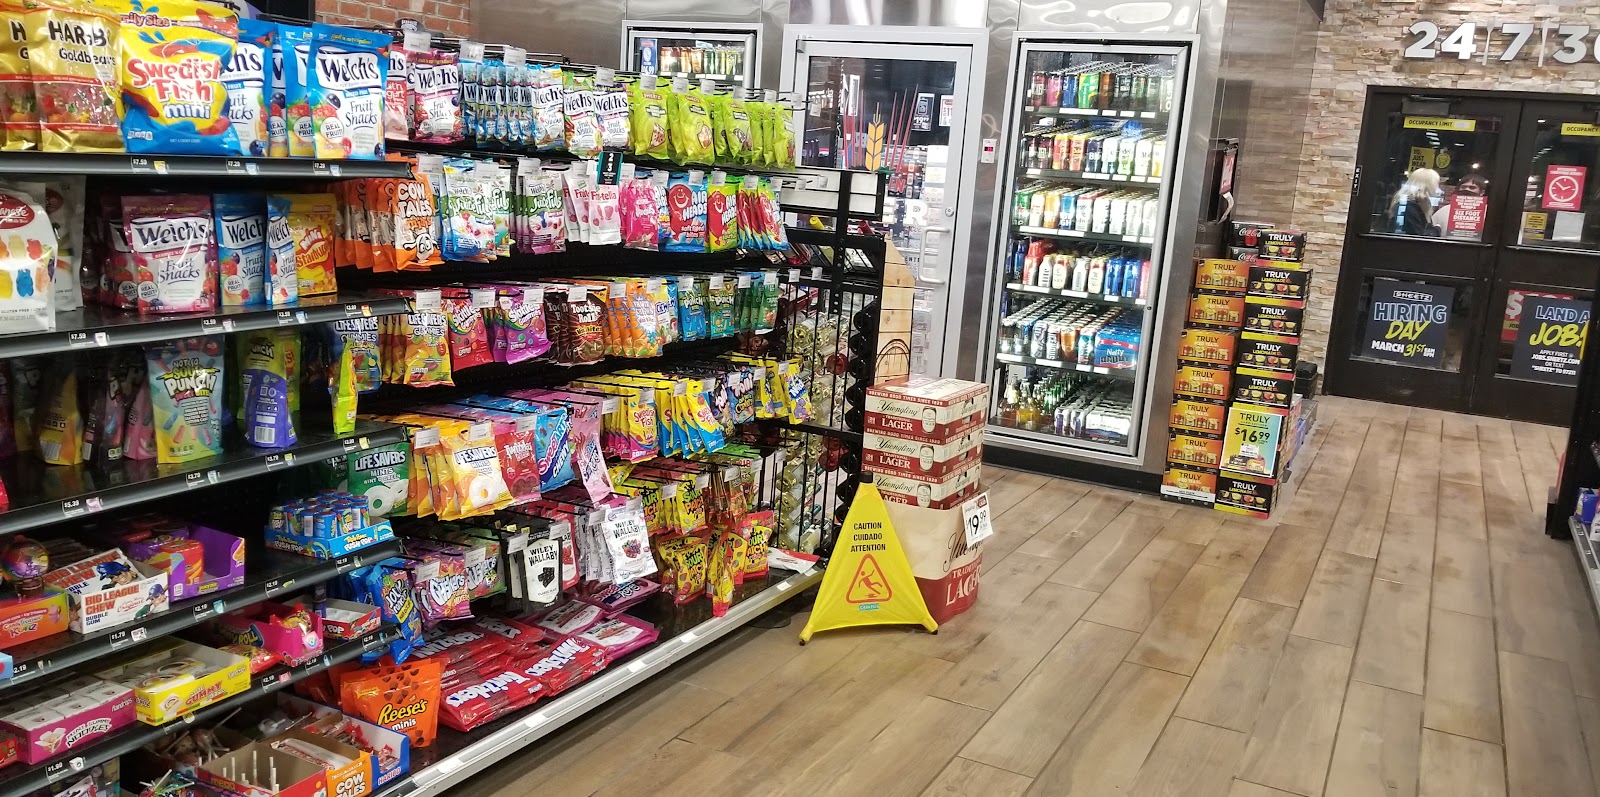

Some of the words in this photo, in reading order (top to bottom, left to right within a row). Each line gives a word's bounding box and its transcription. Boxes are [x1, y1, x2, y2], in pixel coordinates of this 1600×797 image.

[47, 20, 113, 47] HARB
[1405, 20, 1477, 61] 24
[1500, 23, 1535, 62] 7
[1552, 25, 1600, 64] 3
[127, 58, 221, 88] Swedish
[318, 57, 379, 83] Welch's
[417, 68, 458, 89] Welch's
[153, 79, 213, 102] Fish
[350, 100, 373, 115] Fruit
[594, 91, 628, 111] Welch's
[163, 103, 211, 120] mini
[345, 112, 378, 128] Snacks
[1408, 119, 1438, 127] OCCUPANCY
[1353, 167, 1361, 189] EXIT
[397, 182, 425, 201] COW
[691, 190, 708, 206] AIR
[398, 199, 433, 218] TALES
[683, 202, 707, 221] HEADS
[1453, 214, 1481, 222] DISTANCE
[135, 220, 208, 247] Welch's
[1268, 233, 1294, 242] TRULY
[165, 258, 194, 273] Fruit
[157, 267, 201, 284] Snacks
[1264, 270, 1291, 279] TRULY
[1207, 298, 1230, 306] TRULY
[1396, 291, 1430, 300] SHEETZ
[571, 303, 601, 314] Tootsie
[1261, 307, 1287, 316] TRULY
[1374, 302, 1448, 324] HIRING
[1535, 305, 1578, 322] LAND
[1578, 310, 1591, 324] A
[578, 311, 597, 324] Roll
[70, 332, 87, 340] $7.59
[1385, 320, 1432, 341] DAY
[1529, 321, 1591, 348] JOB!
[1195, 335, 1219, 343] TRULY
[1106, 348, 1125, 357] Natty
[1256, 343, 1282, 352] TRULY
[1371, 340, 1405, 354] MARCH
[172, 357, 191, 367] NOT
[1192, 370, 1215, 378] TRULY
[164, 373, 217, 397] PUNCH
[1252, 378, 1278, 387] TRULY
[868, 390, 889, 398] BREWING
[877, 399, 921, 416] Yuengling
[1186, 404, 1210, 413] TRULY
[641, 418, 654, 427] Fish
[881, 418, 914, 431] LAGER
[1240, 412, 1271, 424] TRULY
[866, 427, 886, 435] BREWING
[875, 437, 919, 454] Yuengling
[1184, 438, 1208, 447] TRULY
[553, 442, 570, 478] CHEWY
[879, 455, 911, 469] LAGER
[370, 467, 394, 477] MINTS
[864, 465, 884, 474] BREWING
[1179, 471, 1202, 480] TRULY
[874, 475, 915, 492] Yuengling
[1232, 481, 1257, 491] TRULY
[614, 519, 636, 529] WILEY
[853, 522, 882, 531] CAUTION
[853, 533, 883, 541] CUIDADO
[529, 544, 554, 556] WILEY
[851, 544, 886, 553] ATTENTION
[528, 549, 558, 567] WALLABY
[85, 593, 103, 606] BIG
[103, 584, 140, 603] LEAGUE
[85, 600, 116, 616] CHEW
[85, 612, 109, 622] BUBBLE
[86, 618, 101, 627] GUM
[328, 624, 345, 634] POP
[185, 681, 222, 706] GUMMY
[377, 698, 428, 726] Reese's
[391, 717, 417, 731] minis
[67, 724, 112, 748] NOODLES
[335, 771, 365, 791] COW
[377, 767, 402, 785] HARIBO
